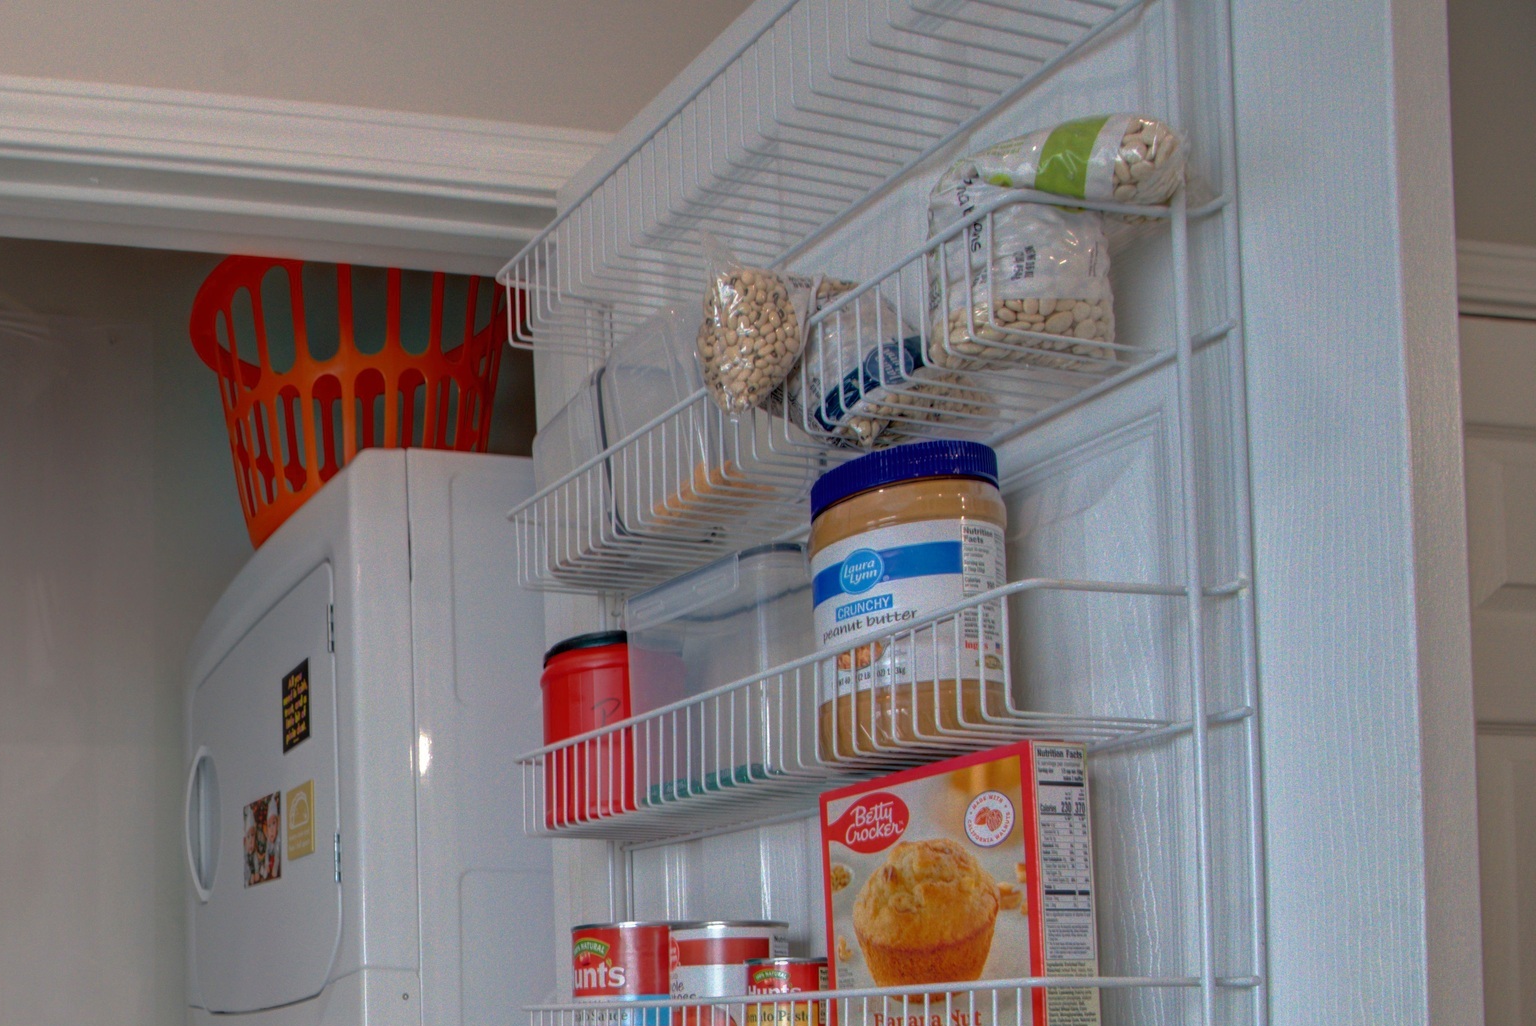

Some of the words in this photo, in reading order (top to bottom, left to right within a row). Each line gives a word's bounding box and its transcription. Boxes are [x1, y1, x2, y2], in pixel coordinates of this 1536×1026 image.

[964, 526, 993, 538] Nutrition
[844, 559, 875, 578] Laura
[850, 569, 878, 586] Lynn
[837, 596, 891, 619] CRUNCHY
[823, 618, 863, 644] peanut
[866, 609, 918, 628] butter
[965, 641, 989, 652] Ings
[1037, 748, 1064, 759] Nutrition
[1066, 749, 1083, 759] Facts
[971, 796, 986, 810] MADE
[988, 793, 1003, 804] WITH
[1061, 801, 1072, 814] 230
[1075, 801, 1086, 814] 370
[850, 801, 894, 828] Betty
[845, 822, 904, 845] Crocker
[967, 819, 994, 842] CALIFORNIA
[994, 811, 1011, 840] WALNUTS
[580, 941, 605, 956] NATURAL
[573, 959, 626, 989] unt's
